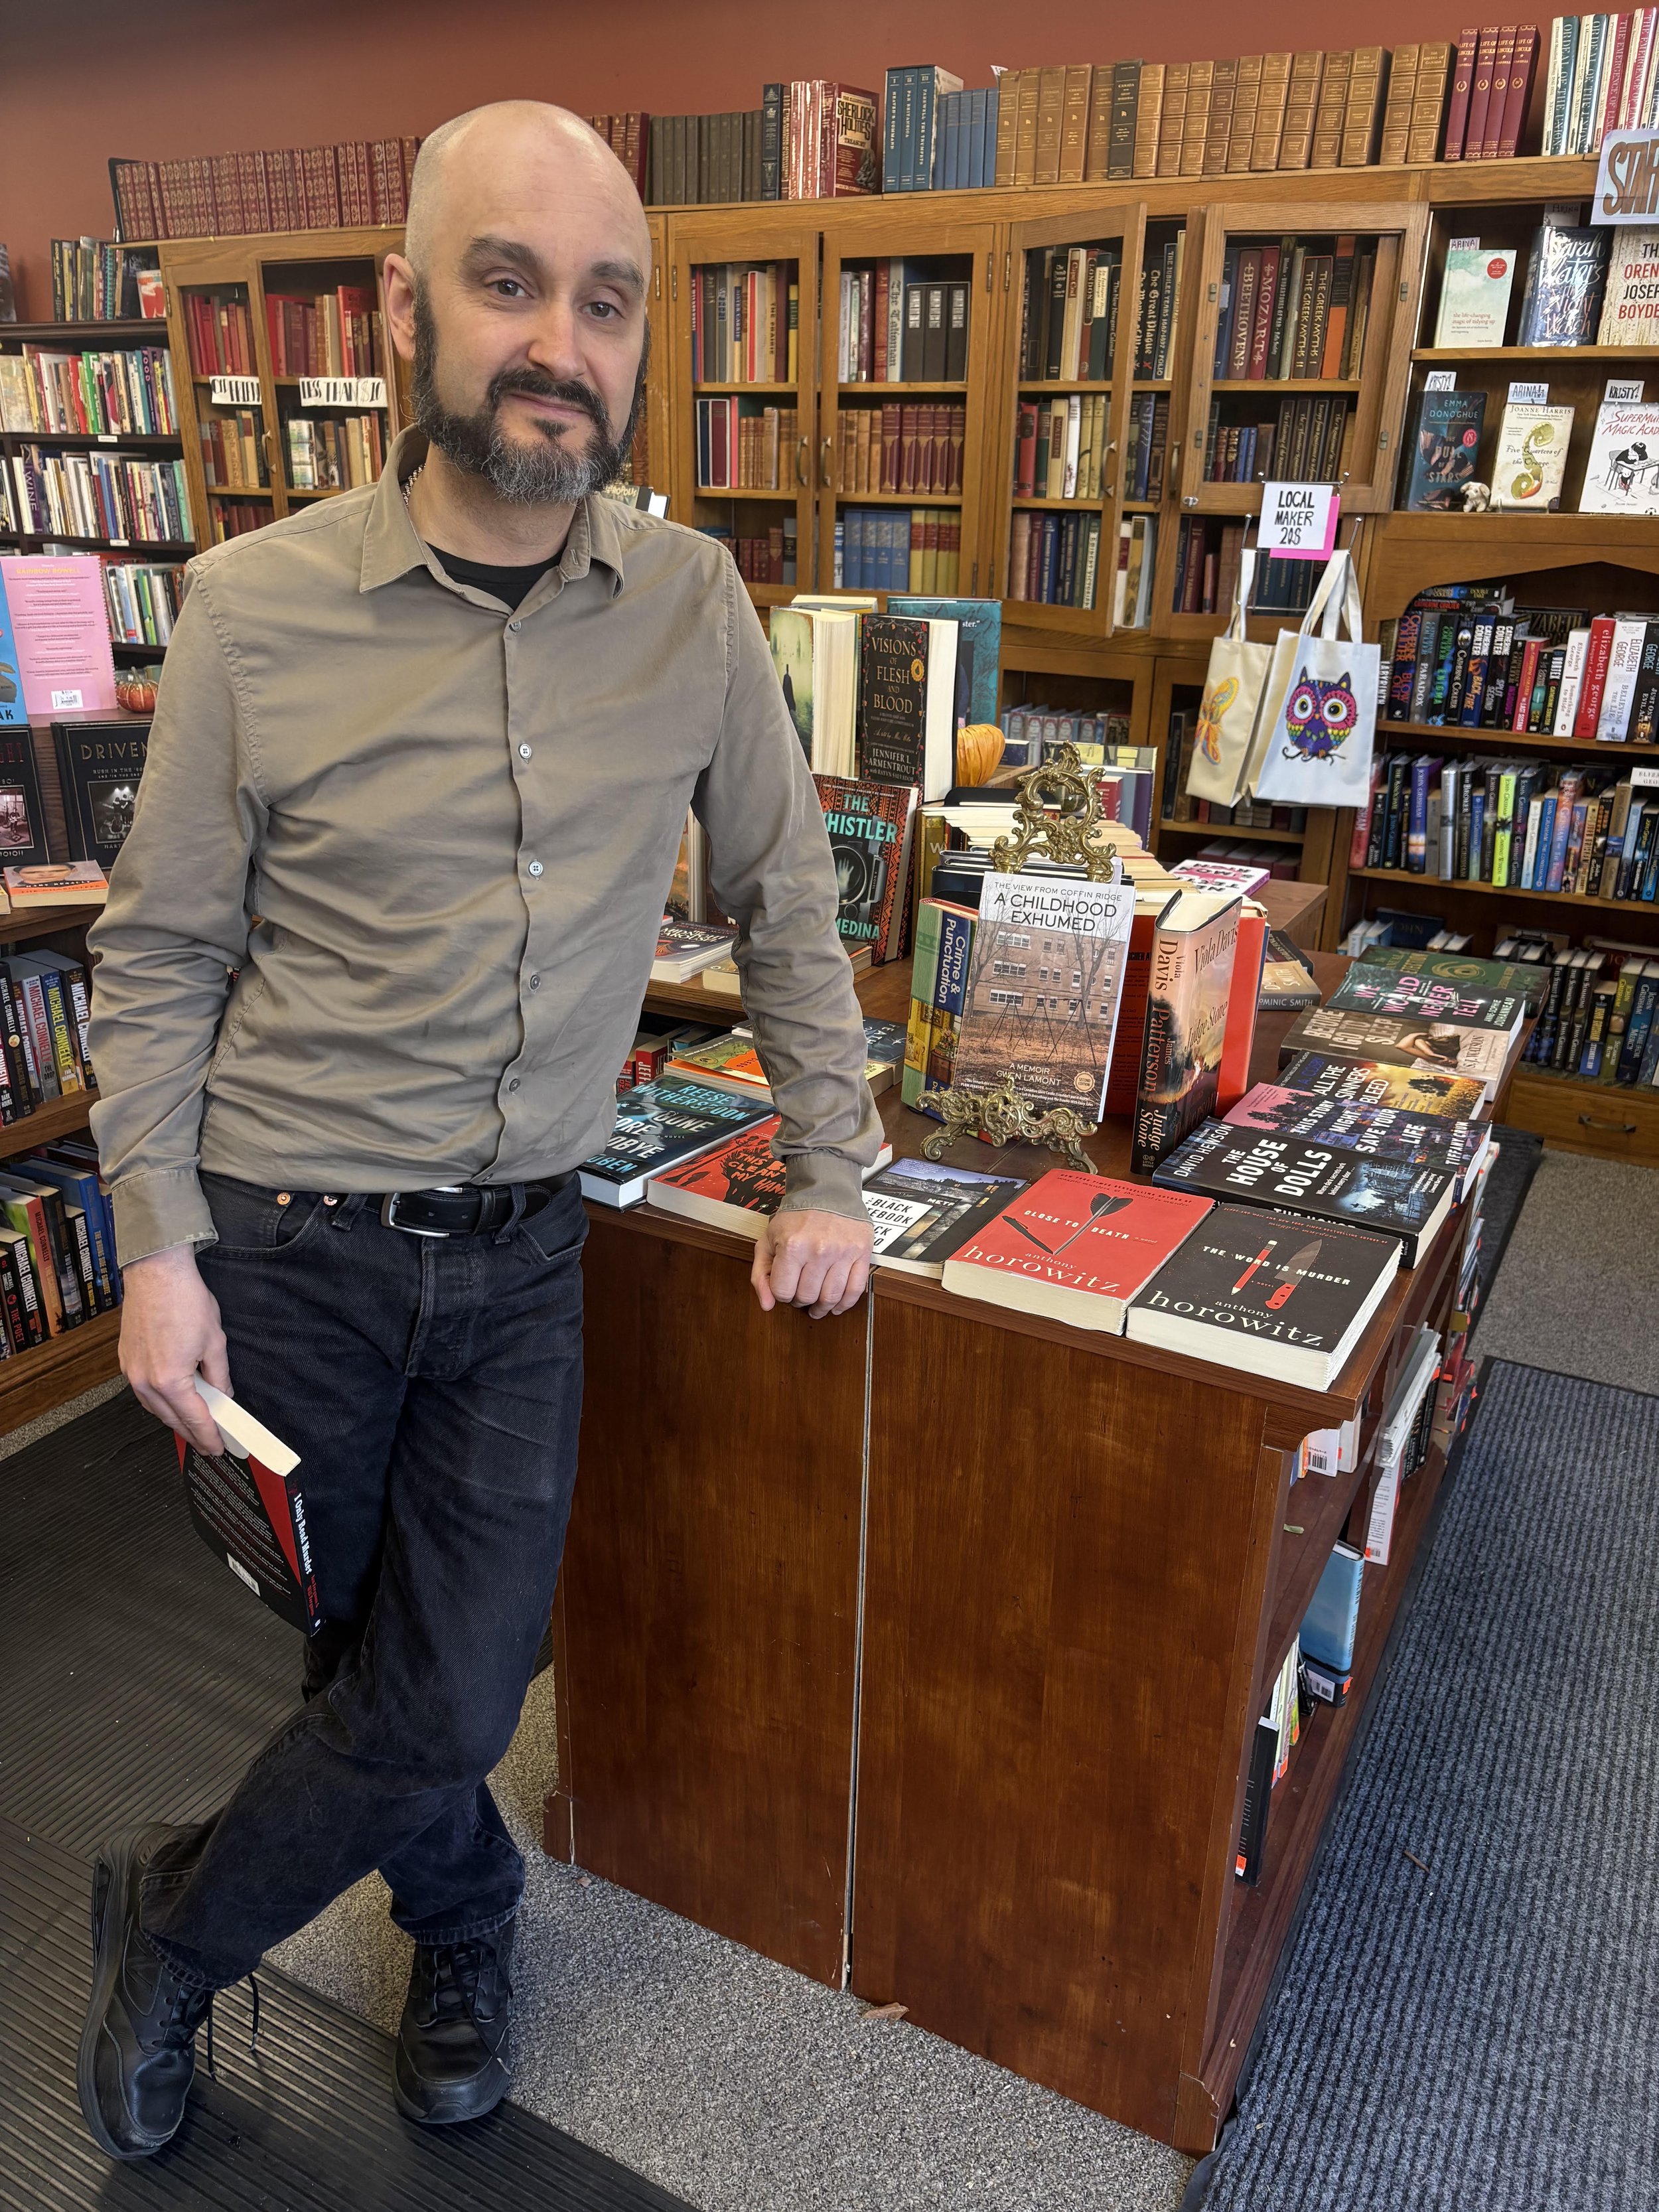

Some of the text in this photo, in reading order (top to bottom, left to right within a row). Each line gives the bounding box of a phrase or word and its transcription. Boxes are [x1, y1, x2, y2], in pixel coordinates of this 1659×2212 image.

[1560, 24, 1573, 86] ORDEAL OF
[1589, 21, 1601, 67] ORDEAL
[1612, 41, 1625, 94] EMERGENCE
[838, 102, 875, 123] SHERLOCK
[841, 117, 871, 141] HOLMES
[1145, 269, 1160, 354] The Great Plague
[1234, 267, 1254, 365] BEETHOVEN
[1256, 277, 1273, 352] MOZART
[1297, 271, 1314, 357] THE GREEK MYTHS
[1310, 270, 1328, 357] THE GREEK MYTHS
[301, 380, 322, 400] LESS
[326, 382, 357, 403] THAN
[1444, 400, 1468, 409] EMMA
[1609, 384, 1640, 400] KRISTY!
[1429, 409, 1479, 419] DONOGHUE
[1509, 405, 1572, 415] JOANNE HARRIS
[1051, 415, 1062, 459] WALDEN
[1602, 423, 1636, 436] MAGIC
[25, 470, 38, 512] WINE
[1428, 471, 1462, 484] STARS
[1278, 490, 1315, 509] LOCAL
[1274, 510, 1315, 526] MAKER
[871, 637, 916, 657] VISIONS
[1471, 625, 1484, 656] COULTER
[1480, 625, 1493, 656] CATHERINE
[1492, 625, 1506, 656] COULTER
[1501, 625, 1514, 656] CATHERINE
[1613, 640, 1628, 668] GEORGE
[1625, 638, 1642, 672] ELIZABETH
[877, 665, 910, 685] FLESH
[1415, 663, 1429, 707] PARADOX
[1587, 628, 1611, 719] elizabeth george
[873, 694, 913, 714] BLOOD
[1464, 692, 1476, 711] FIRE
[1615, 684, 1628, 725] BELIEVING
[868, 757, 916, 776] ARMENTROUT
[872, 748, 905, 763] JENNIFER
[843, 794, 870, 813] THE
[994, 893, 1117, 918] A CHILDHOOD
[1060, 889, 1093, 899] COFFIN
[1096, 893, 1122, 901] RIDGE
[1011, 911, 1096, 932] EXHUMED
[938, 918, 956, 1004] Punctuation
[1194, 935, 1216, 976] Viola
[1215, 921, 1238, 958] Davis
[950, 936, 966, 994] Crime &
[1155, 938, 1179, 991] Davis
[1174, 954, 1186, 979] Viola
[1353, 984, 1381, 999] WE
[1381, 976, 1420, 1013] WOULD
[1551, 977, 1561, 994] STREET
[1565, 979, 1576, 1006] SUMMONS
[1615, 978, 1627, 1007] GRISHAM
[1624, 984, 1634, 1003] JOHN
[1635, 984, 1650, 1015] GRISHAM
[71, 982, 90, 1023] MICHAEL
[1289, 998, 1313, 1007] SMITH
[1417, 985, 1455, 1017] NEVER
[1452, 999, 1482, 1017] TELL
[1646, 991, 1657, 1010] JOHN
[4, 1003, 17, 1033] CONNELLY
[15, 999, 28, 1034] MICHAEL
[29, 985, 53, 1063] MICHAEL CONNELLY
[48, 986, 74, 1067] MICHAEL CONNELLY
[1302, 1008, 1346, 1040] BEFORE
[1143, 1005, 1170, 1093] Patterson
[1164, 1037, 1176, 1065] James
[1626, 1028, 1639, 1051] MERCY
[1017, 1065, 1050, 1074] MEMOIR
[1023, 1076, 1061, 1086] LAMONT
[678, 1084, 736, 1106] REESE
[1334, 1067, 1372, 1101] SINNERS
[1358, 1078, 1390, 1105] BLEED
[631, 1084, 752, 1122] WITHERSPOON
[1293, 1099, 1336, 1135] THIS STORY
[652, 1110, 716, 1134] GONE
[1137, 1108, 1152, 1148] Stone
[1151, 1109, 1168, 1151] Judge
[1329, 1110, 1361, 1134] MIGHT
[1399, 1122, 1427, 1145] LIFE
[739, 1152, 768, 1166] THIS
[1173, 1124, 1235, 1178] DAVID HEWSON
[1221, 1149, 1246, 1165] THE
[1225, 1138, 1289, 1187] HOUSE
[1445, 1136, 1465, 1165] TIFFANY
[729, 1161, 780, 1179] CLEAN
[731, 1171, 753, 1183] MY
[1270, 1161, 1290, 1173] OF
[1273, 1149, 1333, 1197] DOLLS
[1114, 1185, 1155, 1196] BESTSELLING
[872, 1198, 914, 1214] BLACK
[1024, 1209, 1080, 1228] CLOSE TO
[35, 1211, 46, 1236] MICHAEL
[1090, 1226, 1130, 1241] DEATH
[74, 1216, 94, 1282] MICHAEL CONNELLY
[1025, 1252, 1078, 1270] anthony
[14, 1239, 38, 1313] MICHAEL CONNELLY
[961, 1245, 1121, 1293] horowitz
[1202, 1245, 1351, 1287] THE WORD IS MURDER
[1146, 1290, 1325, 1348] horowitz
[1214, 1299, 1274, 1319] anthony
[11, 1309, 25, 1344] THE POET
[294, 1499, 314, 1576] Only Read Murder
